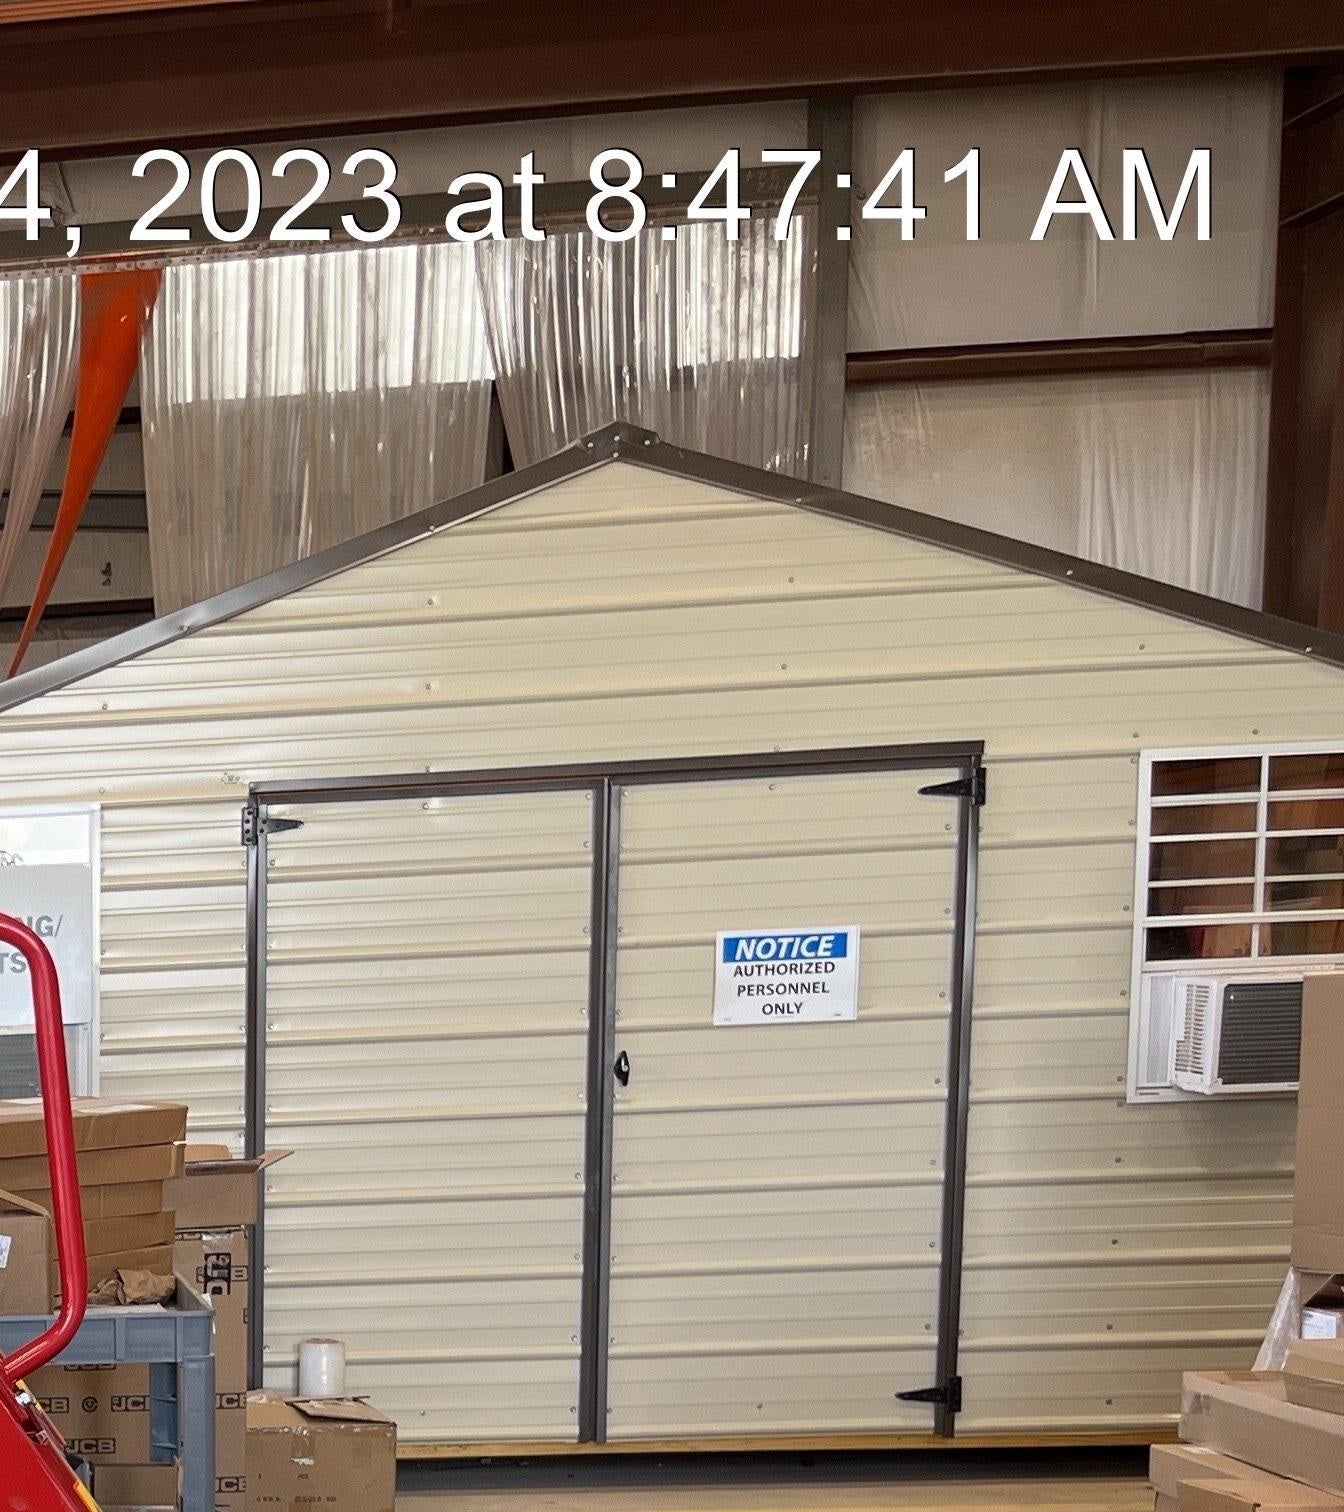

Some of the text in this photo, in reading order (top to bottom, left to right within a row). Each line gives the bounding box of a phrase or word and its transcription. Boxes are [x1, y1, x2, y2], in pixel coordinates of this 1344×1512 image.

[734, 935, 835, 961] NOTICE
[733, 961, 836, 978] AUTHORIZED
[736, 981, 830, 997] PERSONNEL
[761, 1002, 804, 1016] ONLY
[111, 1395, 150, 1412] JC
[64, 1438, 116, 1454] JCB
